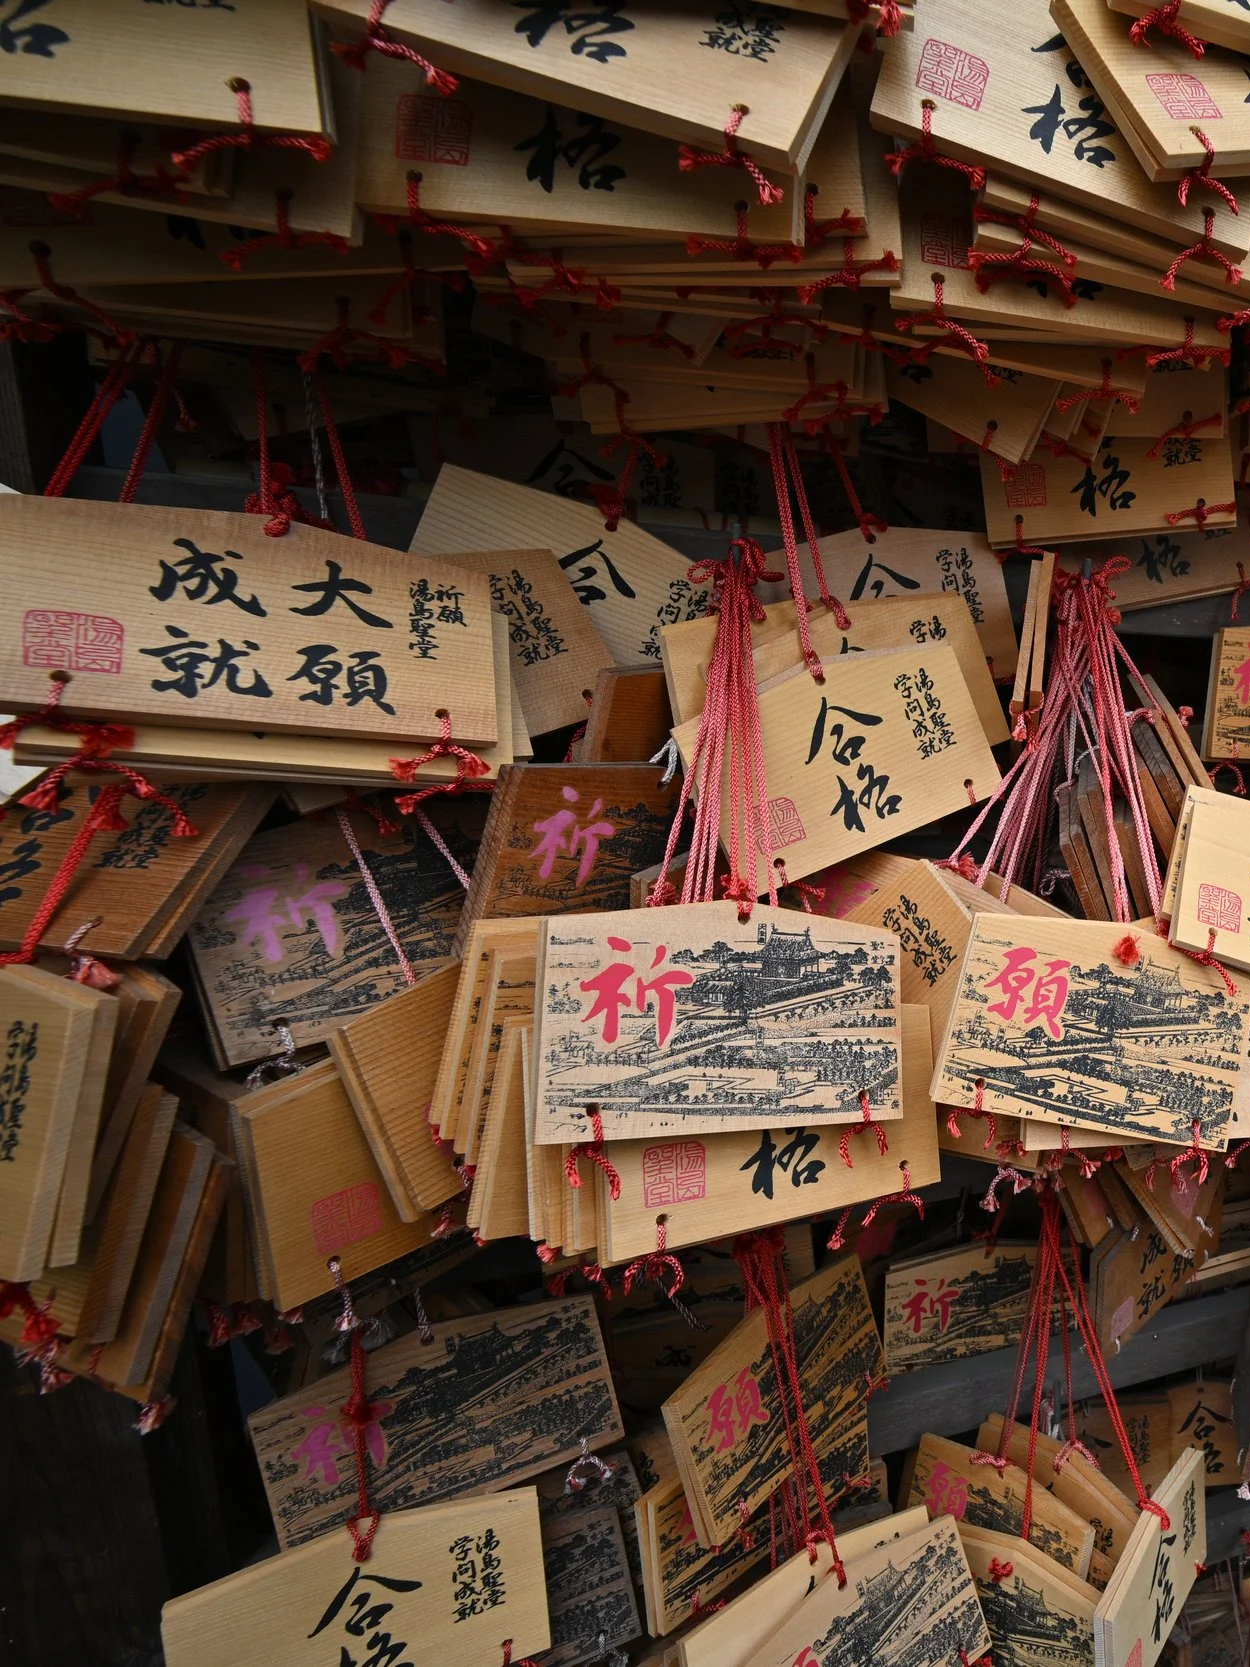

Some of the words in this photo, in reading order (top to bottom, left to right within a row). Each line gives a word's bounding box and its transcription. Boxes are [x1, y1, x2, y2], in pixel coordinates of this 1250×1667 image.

[435, 583, 467, 628] 祈願
[506, 570, 568, 655] 湯島聖堂
[557, 538, 636, 605] 合
[954, 547, 984, 624] 湯島聖堂
[138, 537, 273, 698] 成就
[288, 558, 395, 717] 大願
[409, 578, 438, 660] 湯島聖堂
[489, 575, 547, 666] 学問成就
[894, 674, 943, 760] 学問成就
[914, 668, 958, 747] 湯島聖堂
[805, 697, 902, 832] 合格
[527, 787, 617, 888] 祈
[223, 865, 348, 963] 祈
[883, 908, 946, 987] 学問成就
[901, 895, 957, 963] 湯島聖堂
[580, 936, 694, 1048] 祈
[985, 947, 1071, 1039] 願
[740, 1131, 826, 1200] 格
[902, 1278, 960, 1333] 祈
[1137, 1232, 1167, 1320] 成就
[708, 1366, 770, 1454] 願
[449, 1535, 484, 1623] 学問成就
[476, 1528, 505, 1610] 湯島聖堂
[1149, 1534, 1178, 1644] 合格
